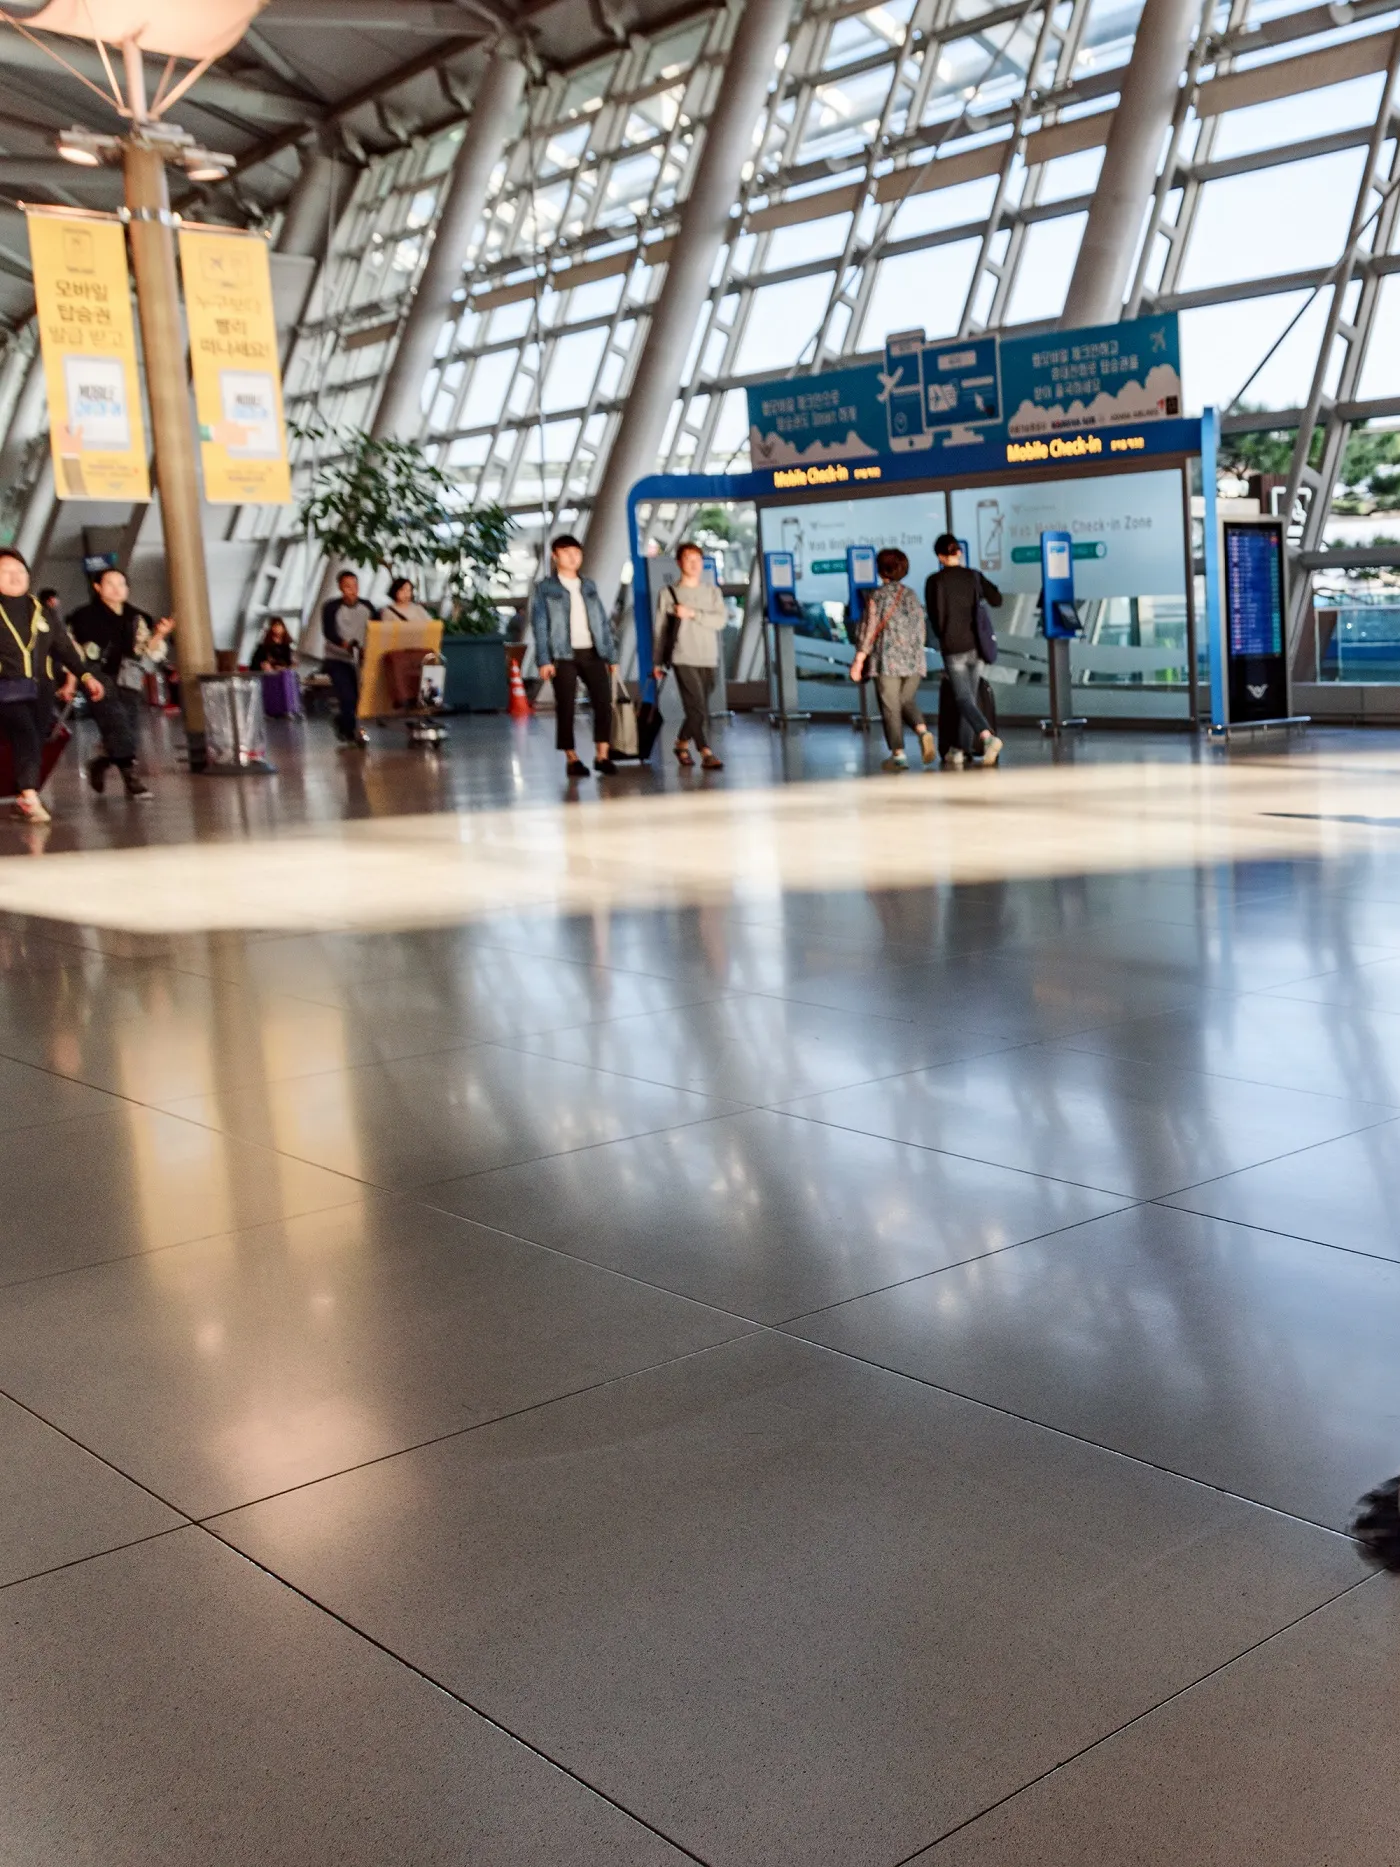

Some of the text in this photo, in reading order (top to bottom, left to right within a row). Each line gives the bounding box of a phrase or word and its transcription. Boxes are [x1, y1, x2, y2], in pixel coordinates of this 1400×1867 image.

[55, 279, 108, 302] 모바일
[57, 304, 112, 326] 탑승권
[1007, 440, 1048, 463] Mobile
[1049, 434, 1102, 458] Check-in
[774, 468, 807, 488] Mobile
[807, 464, 849, 485] Check-in
[1123, 514, 1153, 530] Zone
[901, 531, 923, 546] Zone
